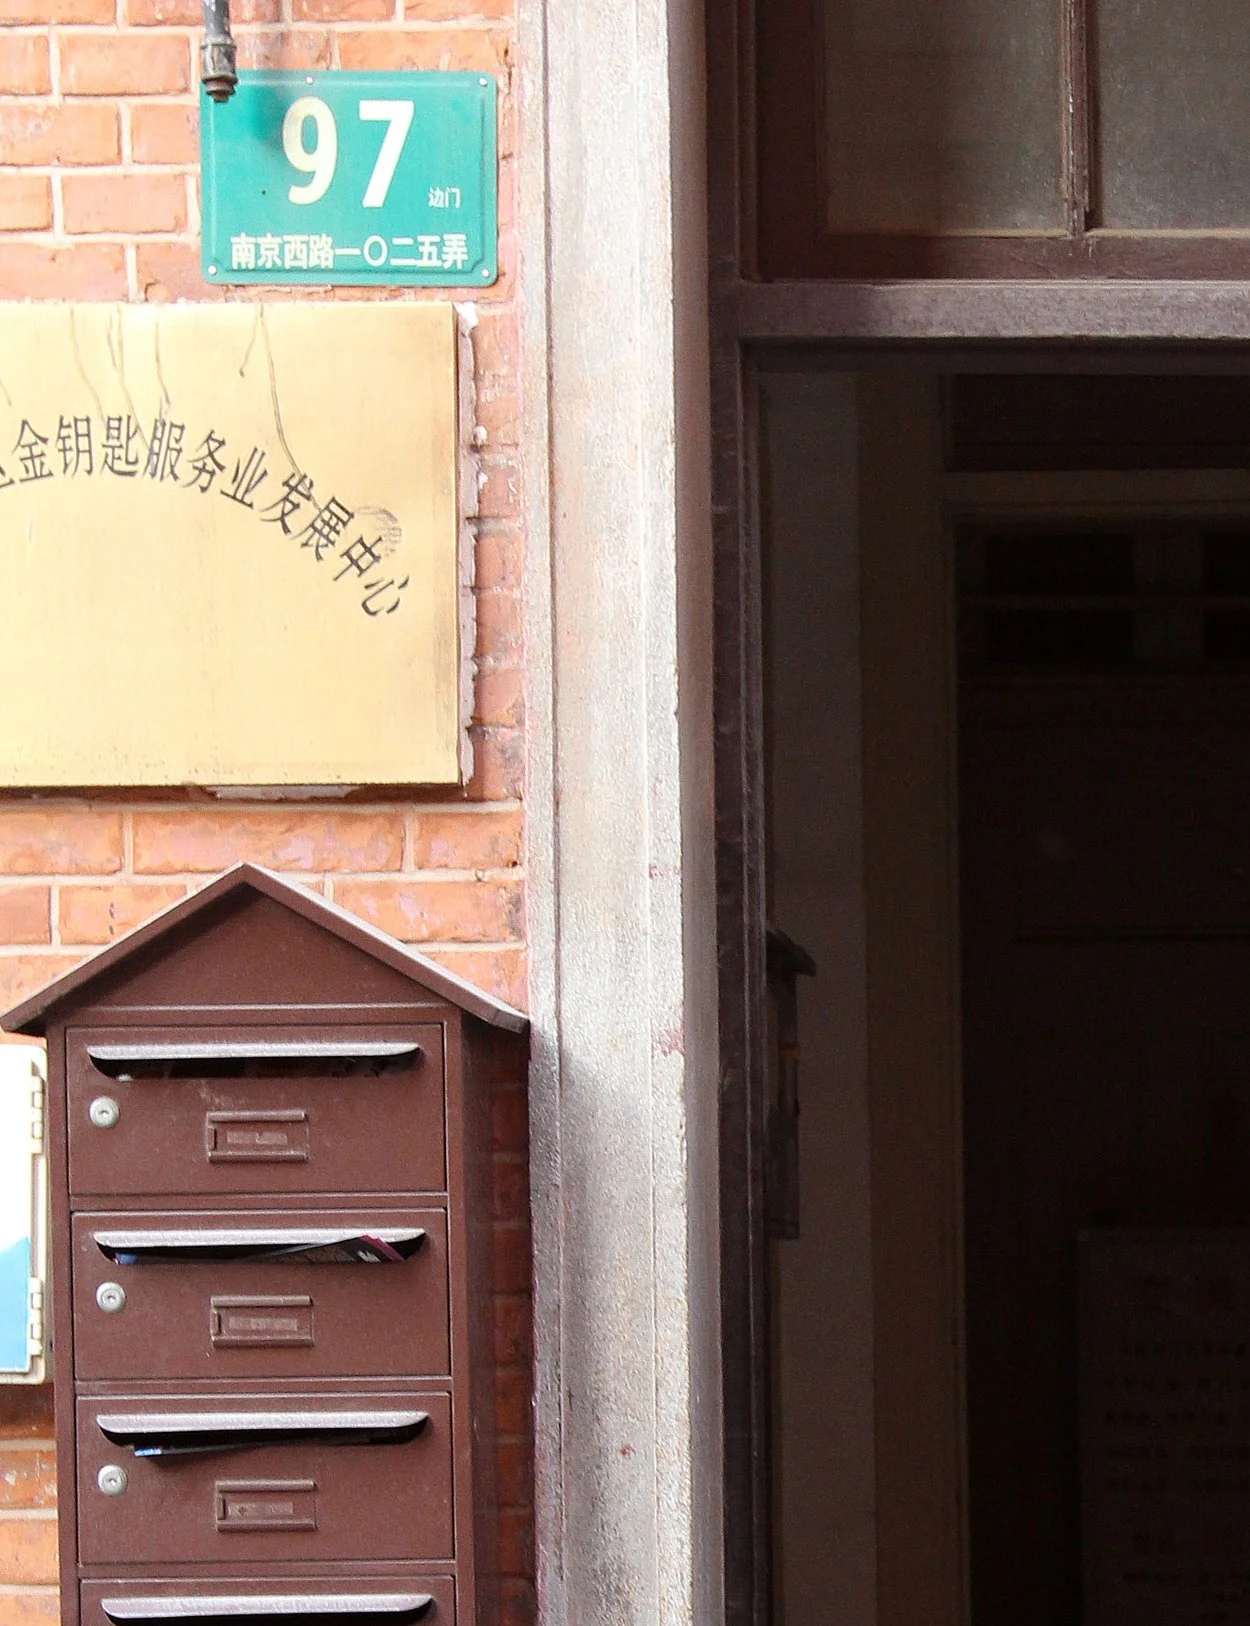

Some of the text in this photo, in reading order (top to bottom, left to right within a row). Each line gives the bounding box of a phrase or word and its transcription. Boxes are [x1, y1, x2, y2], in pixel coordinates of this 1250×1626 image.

[282, 96, 414, 208] 97
[428, 187, 461, 209] 边门
[0, 415, 410, 617] 金钥匙服务业发展中心
